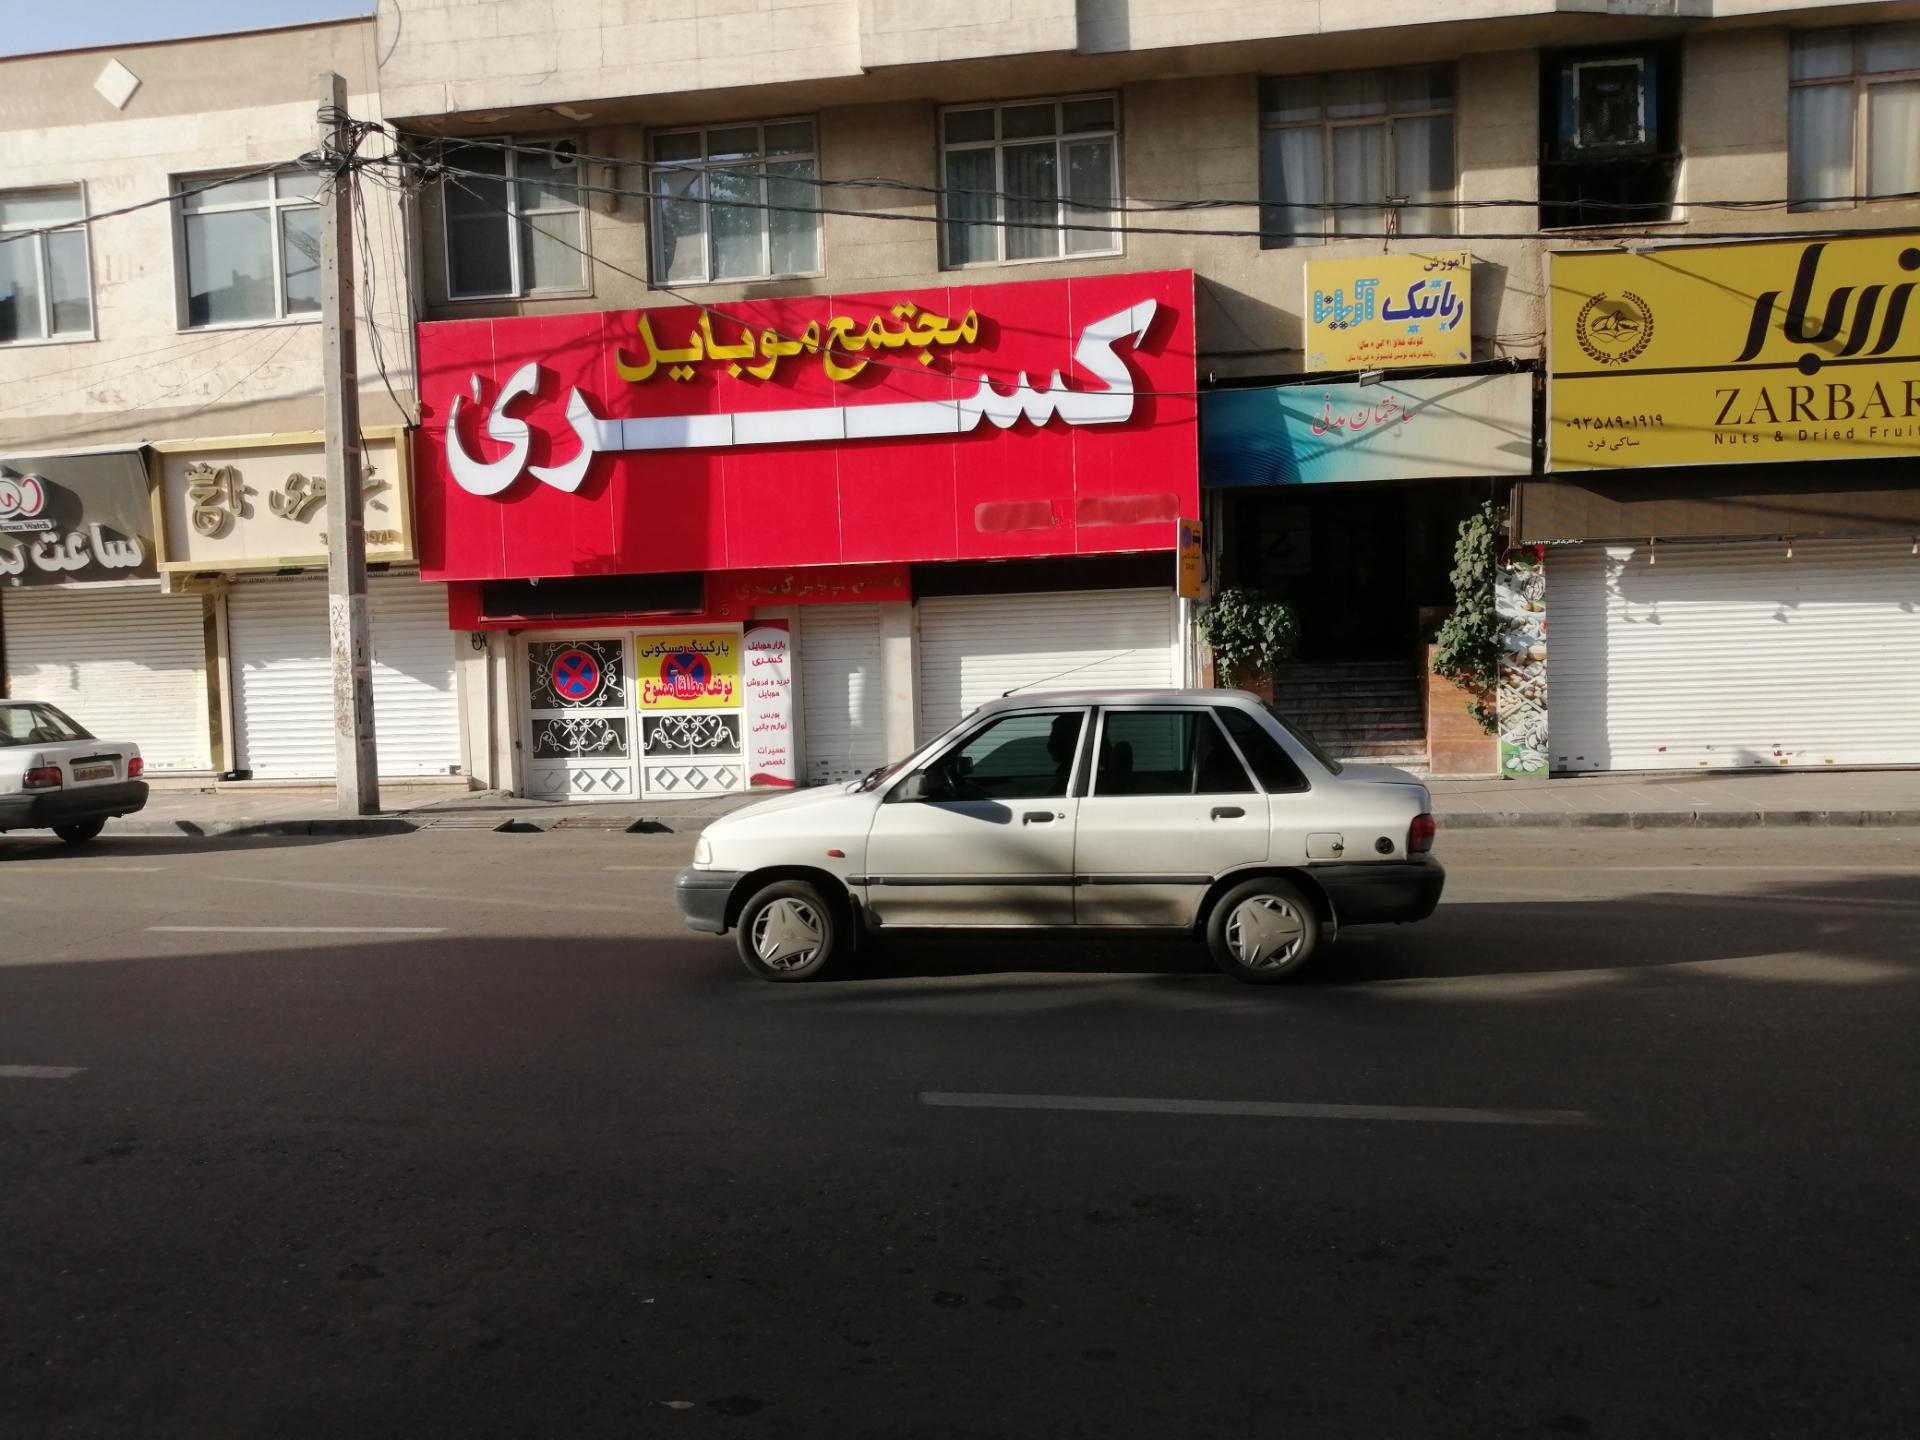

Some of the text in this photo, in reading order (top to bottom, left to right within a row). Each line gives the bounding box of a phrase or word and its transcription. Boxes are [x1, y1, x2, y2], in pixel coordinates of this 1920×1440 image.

[1423, 252, 1468, 271] آموزش
[1382, 278, 1464, 334] رباتیک
[615, 301, 979, 382] مجتمع موبایل
[1311, 391, 1417, 436] ساختمان مدنی
[1566, 413, 1664, 430] ۰۹۳۵۸۹۰۱۹۱۹
[1587, 437, 1606, 451] فرد
[1714, 432, 1760, 445] Nuts
[1774, 430, 1784, 442] &
[1798, 427, 1855, 441] Dried
[31, 522, 146, 572] ساعت
[641, 640, 730, 658] پارکینگ مسکونی
[748, 640, 786, 651] بازار موبایل
[752, 654, 783, 667] کسری
[643, 679, 674, 704] ممنوع
[707, 673, 733, 703] توقف
[746, 678, 768, 687] فروش
[758, 689, 779, 699] موبایل
